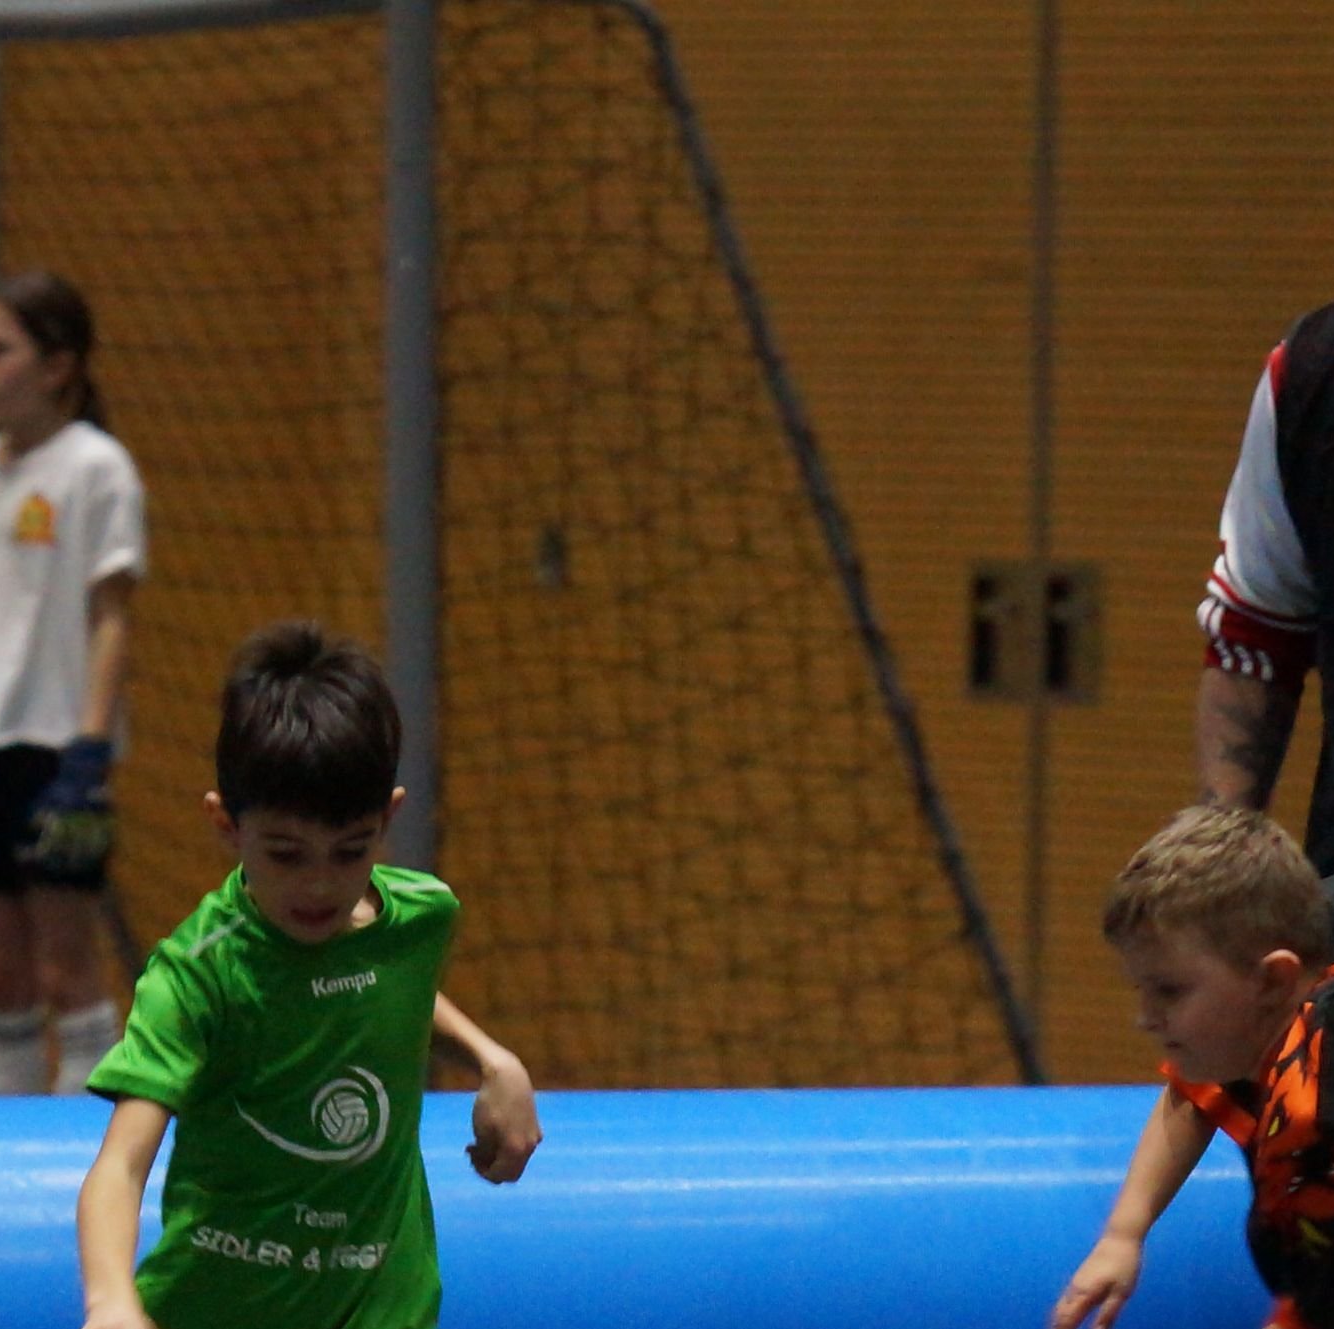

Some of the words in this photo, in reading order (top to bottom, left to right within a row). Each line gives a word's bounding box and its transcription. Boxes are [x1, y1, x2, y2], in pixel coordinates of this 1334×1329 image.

[310, 969, 377, 998] Kempa
[293, 1202, 348, 1229] Team
[301, 1247, 321, 1273] &
